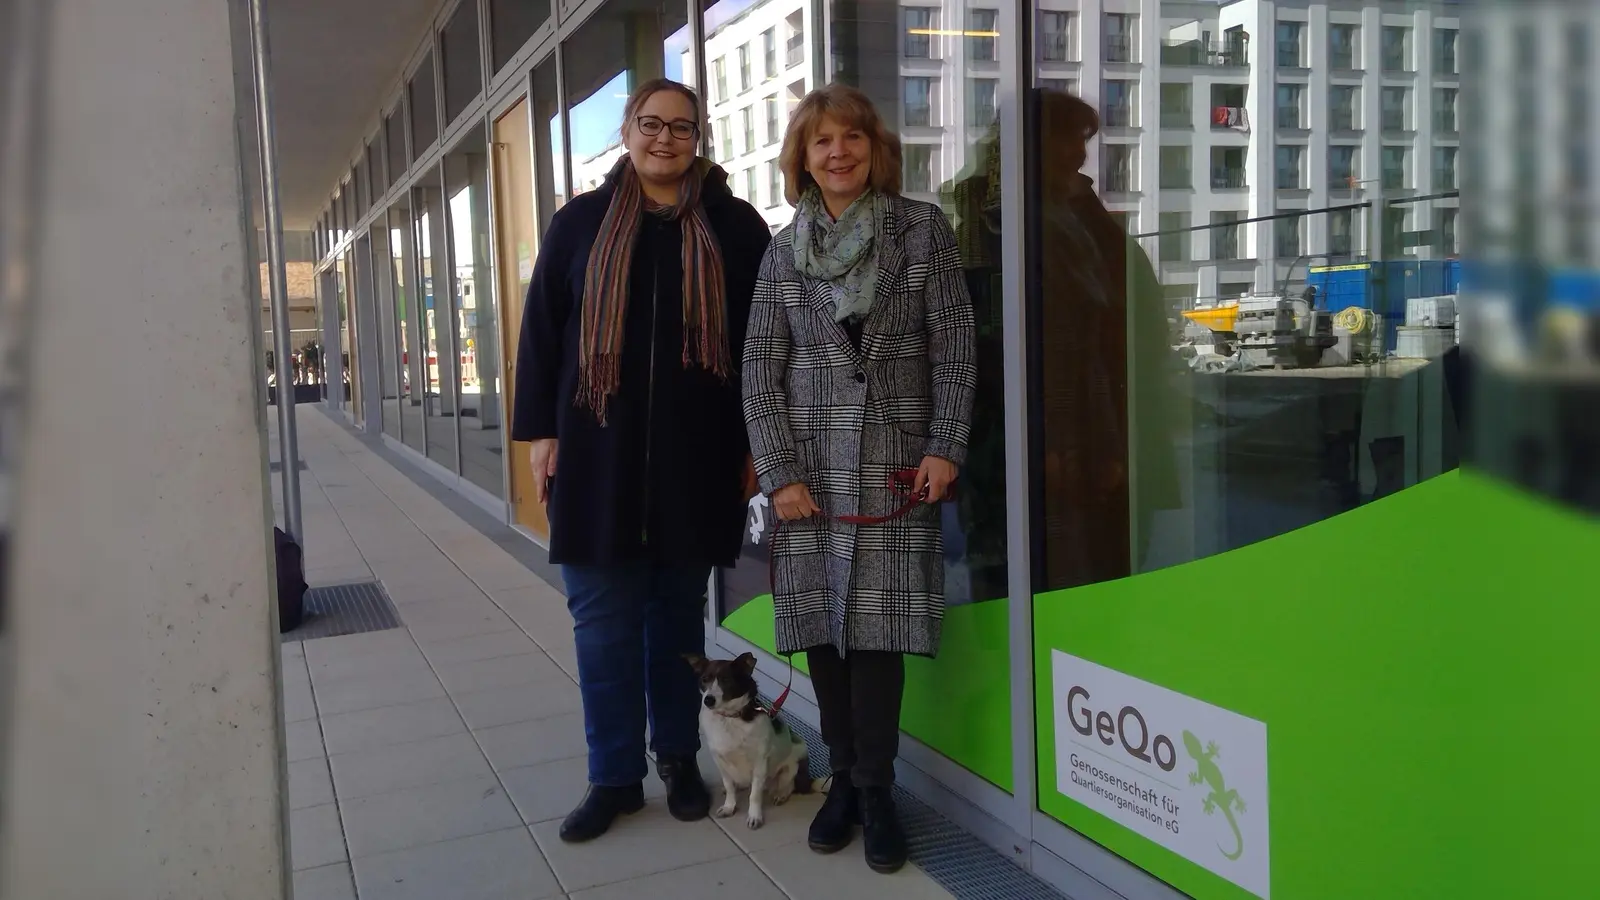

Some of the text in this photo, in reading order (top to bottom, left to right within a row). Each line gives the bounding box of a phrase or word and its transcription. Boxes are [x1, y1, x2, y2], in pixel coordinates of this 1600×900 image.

[1067, 685, 1176, 772] GeQo
[1070, 753, 1180, 816] Genossenschaft für
[1071, 770, 1180, 834] Quartiersorganisation eG
